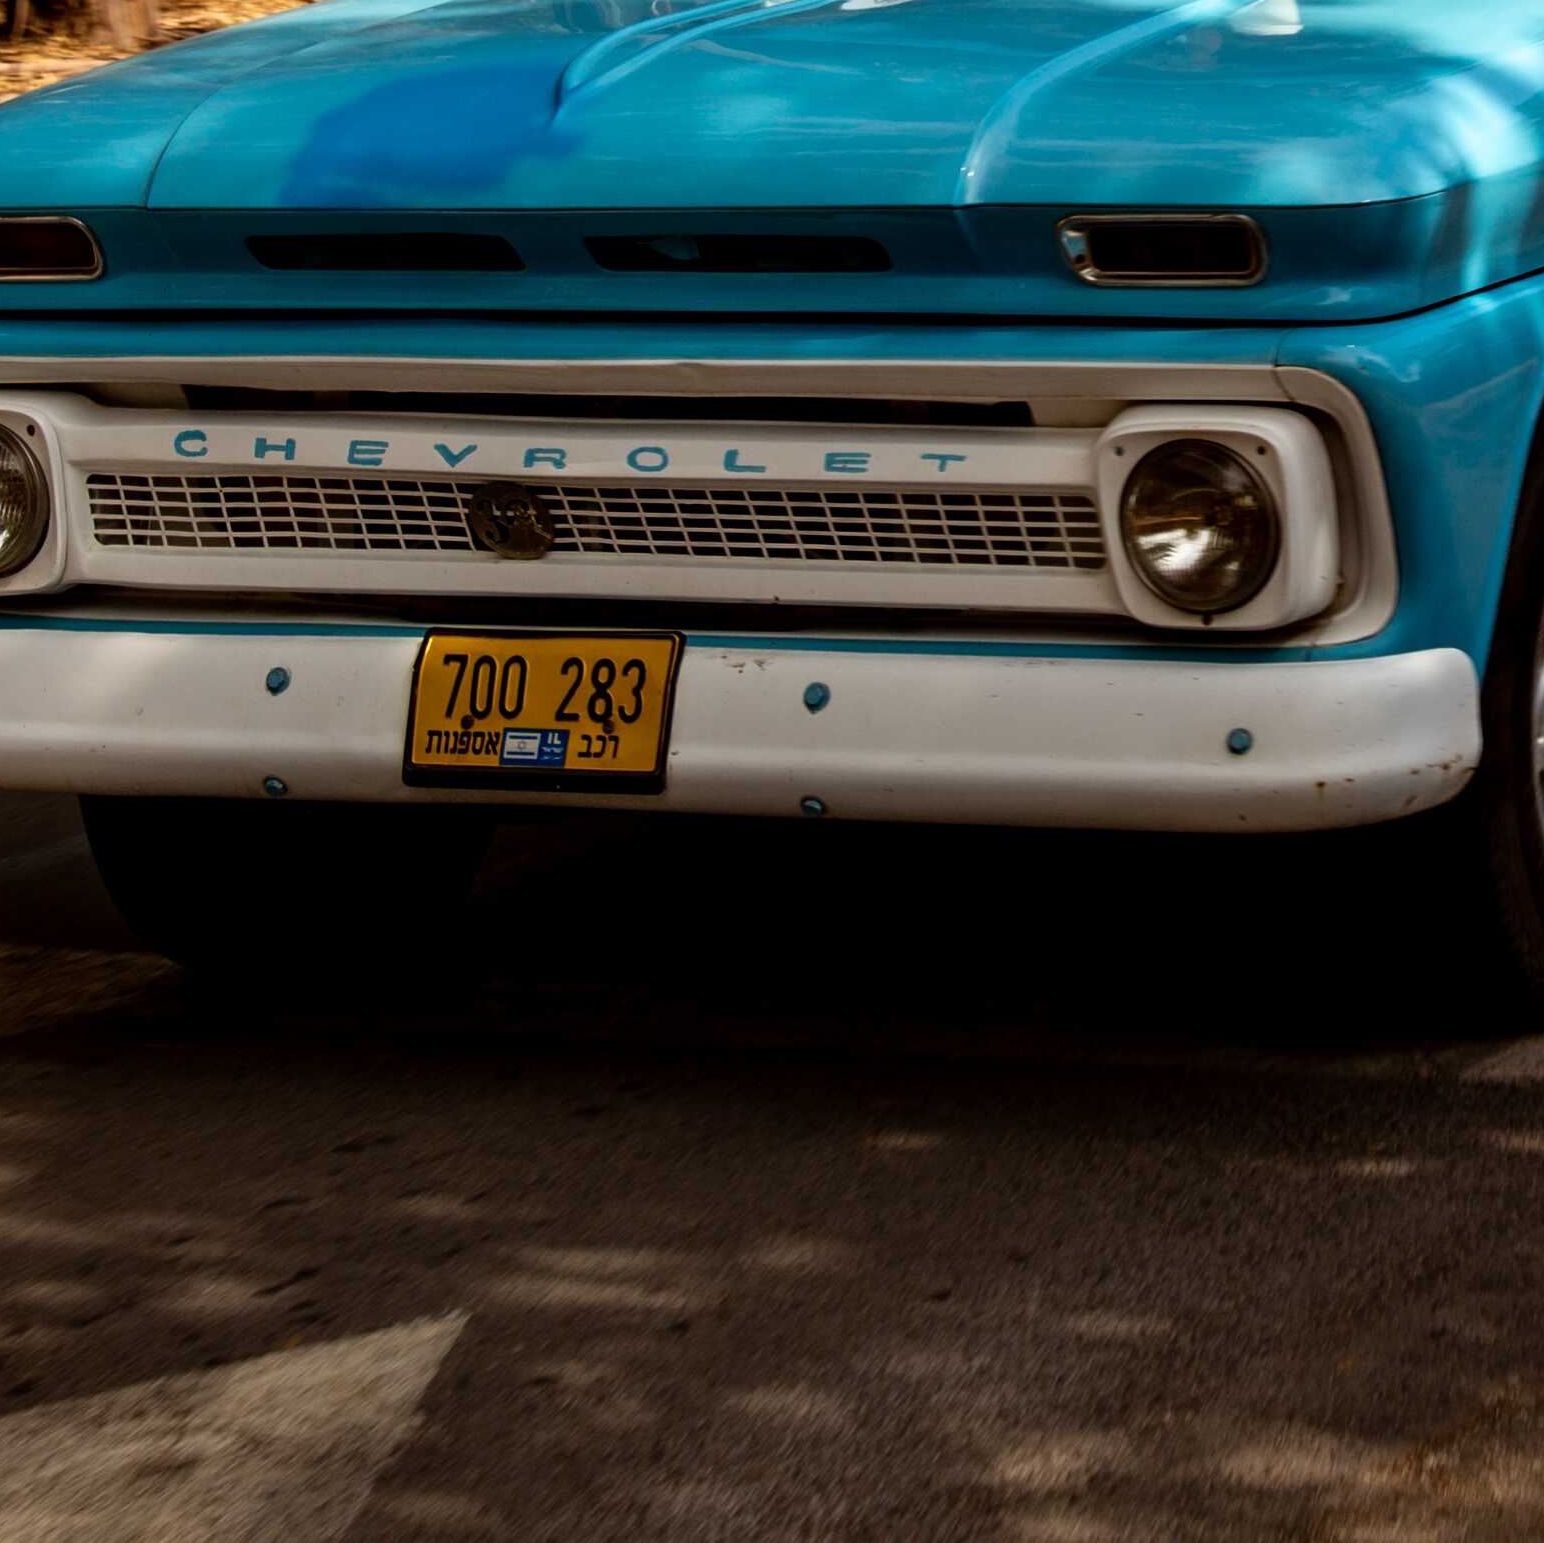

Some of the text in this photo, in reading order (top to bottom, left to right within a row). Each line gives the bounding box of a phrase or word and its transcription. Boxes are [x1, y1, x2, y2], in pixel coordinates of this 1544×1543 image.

[174, 429, 967, 473] CHEVROLET
[443, 654, 647, 724] 700 283
[425, 729, 501, 755] אספנות
[577, 734, 620, 759] רכב
